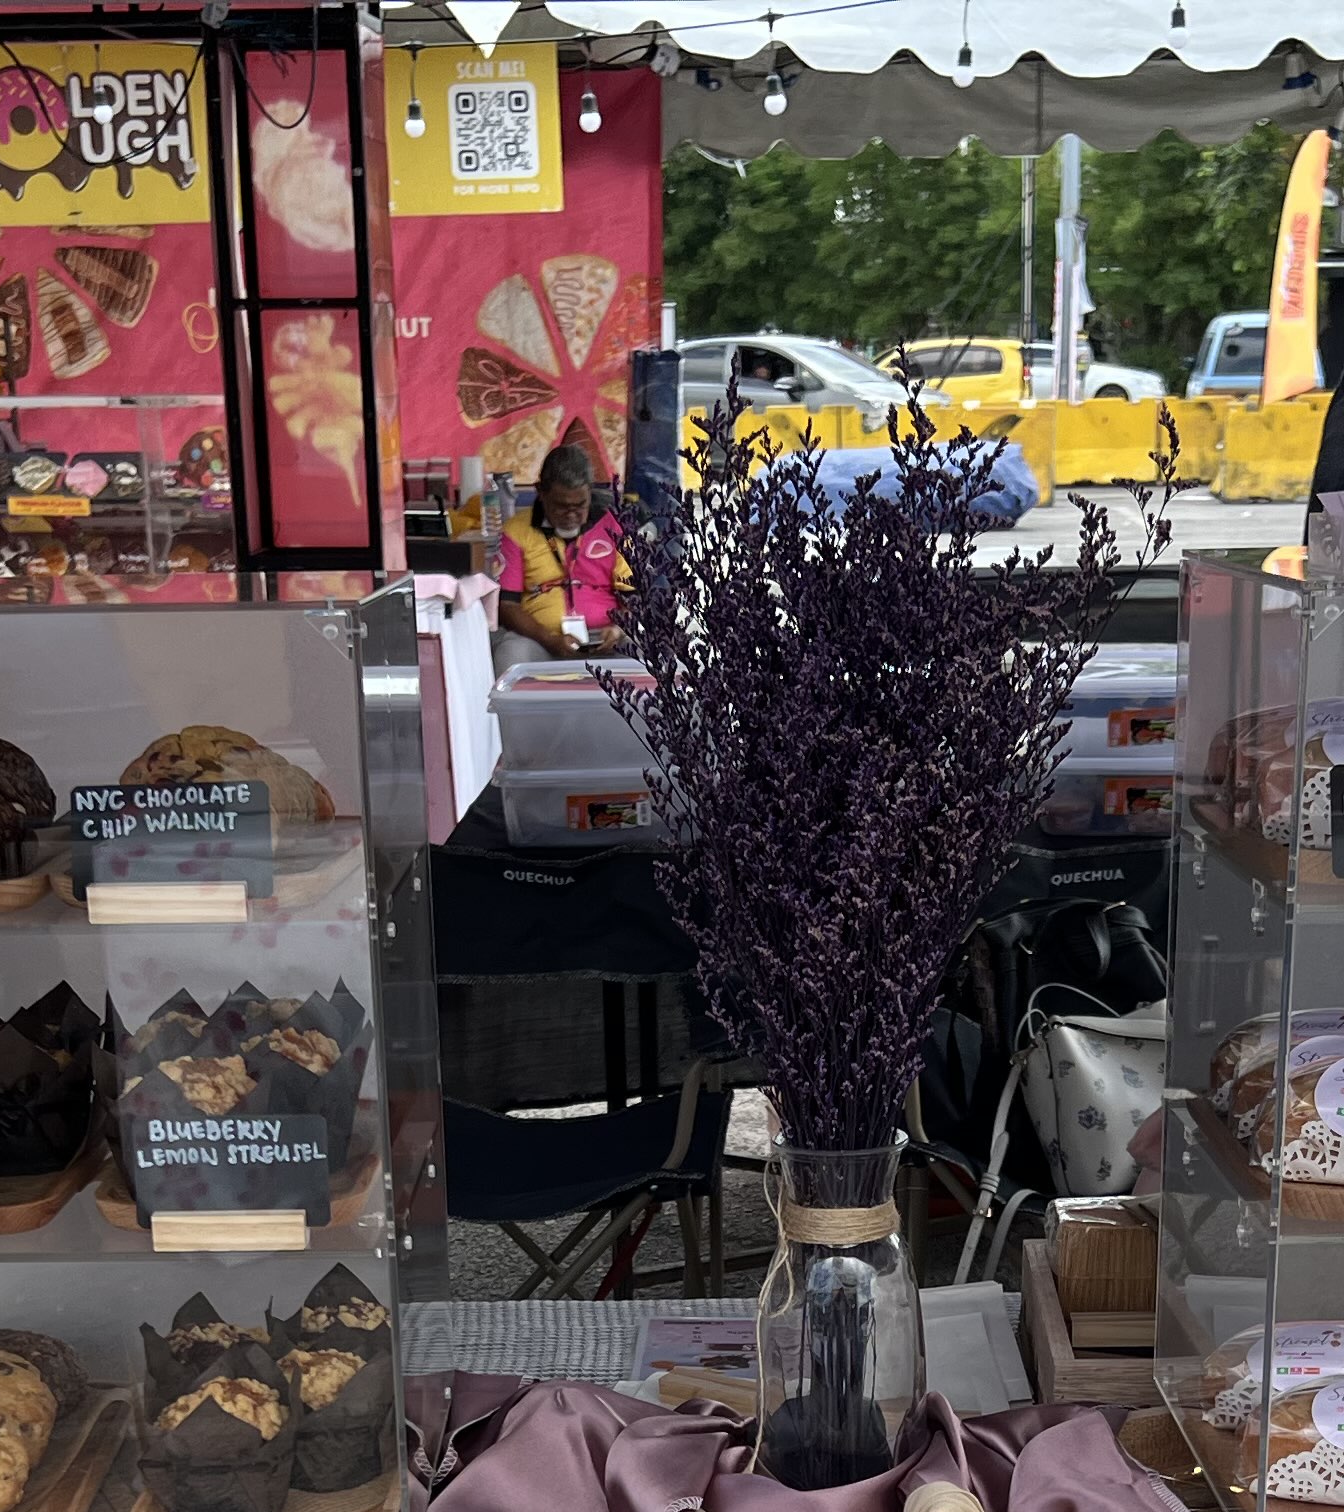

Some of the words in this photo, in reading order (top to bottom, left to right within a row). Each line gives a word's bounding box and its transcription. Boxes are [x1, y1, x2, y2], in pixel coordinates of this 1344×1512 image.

[75, 789, 125, 812] NYC
[134, 784, 251, 809] CHOCOLATE
[82, 814, 138, 840] CHIP
[144, 811, 239, 833] WALNUT
[503, 870, 575, 886] QUECHUA
[1051, 868, 1125, 886] QUECHUA
[149, 1119, 282, 1142] BLUEBERRY
[137, 1145, 218, 1168] LEMON
[227, 1142, 327, 1164] STREUSEL
